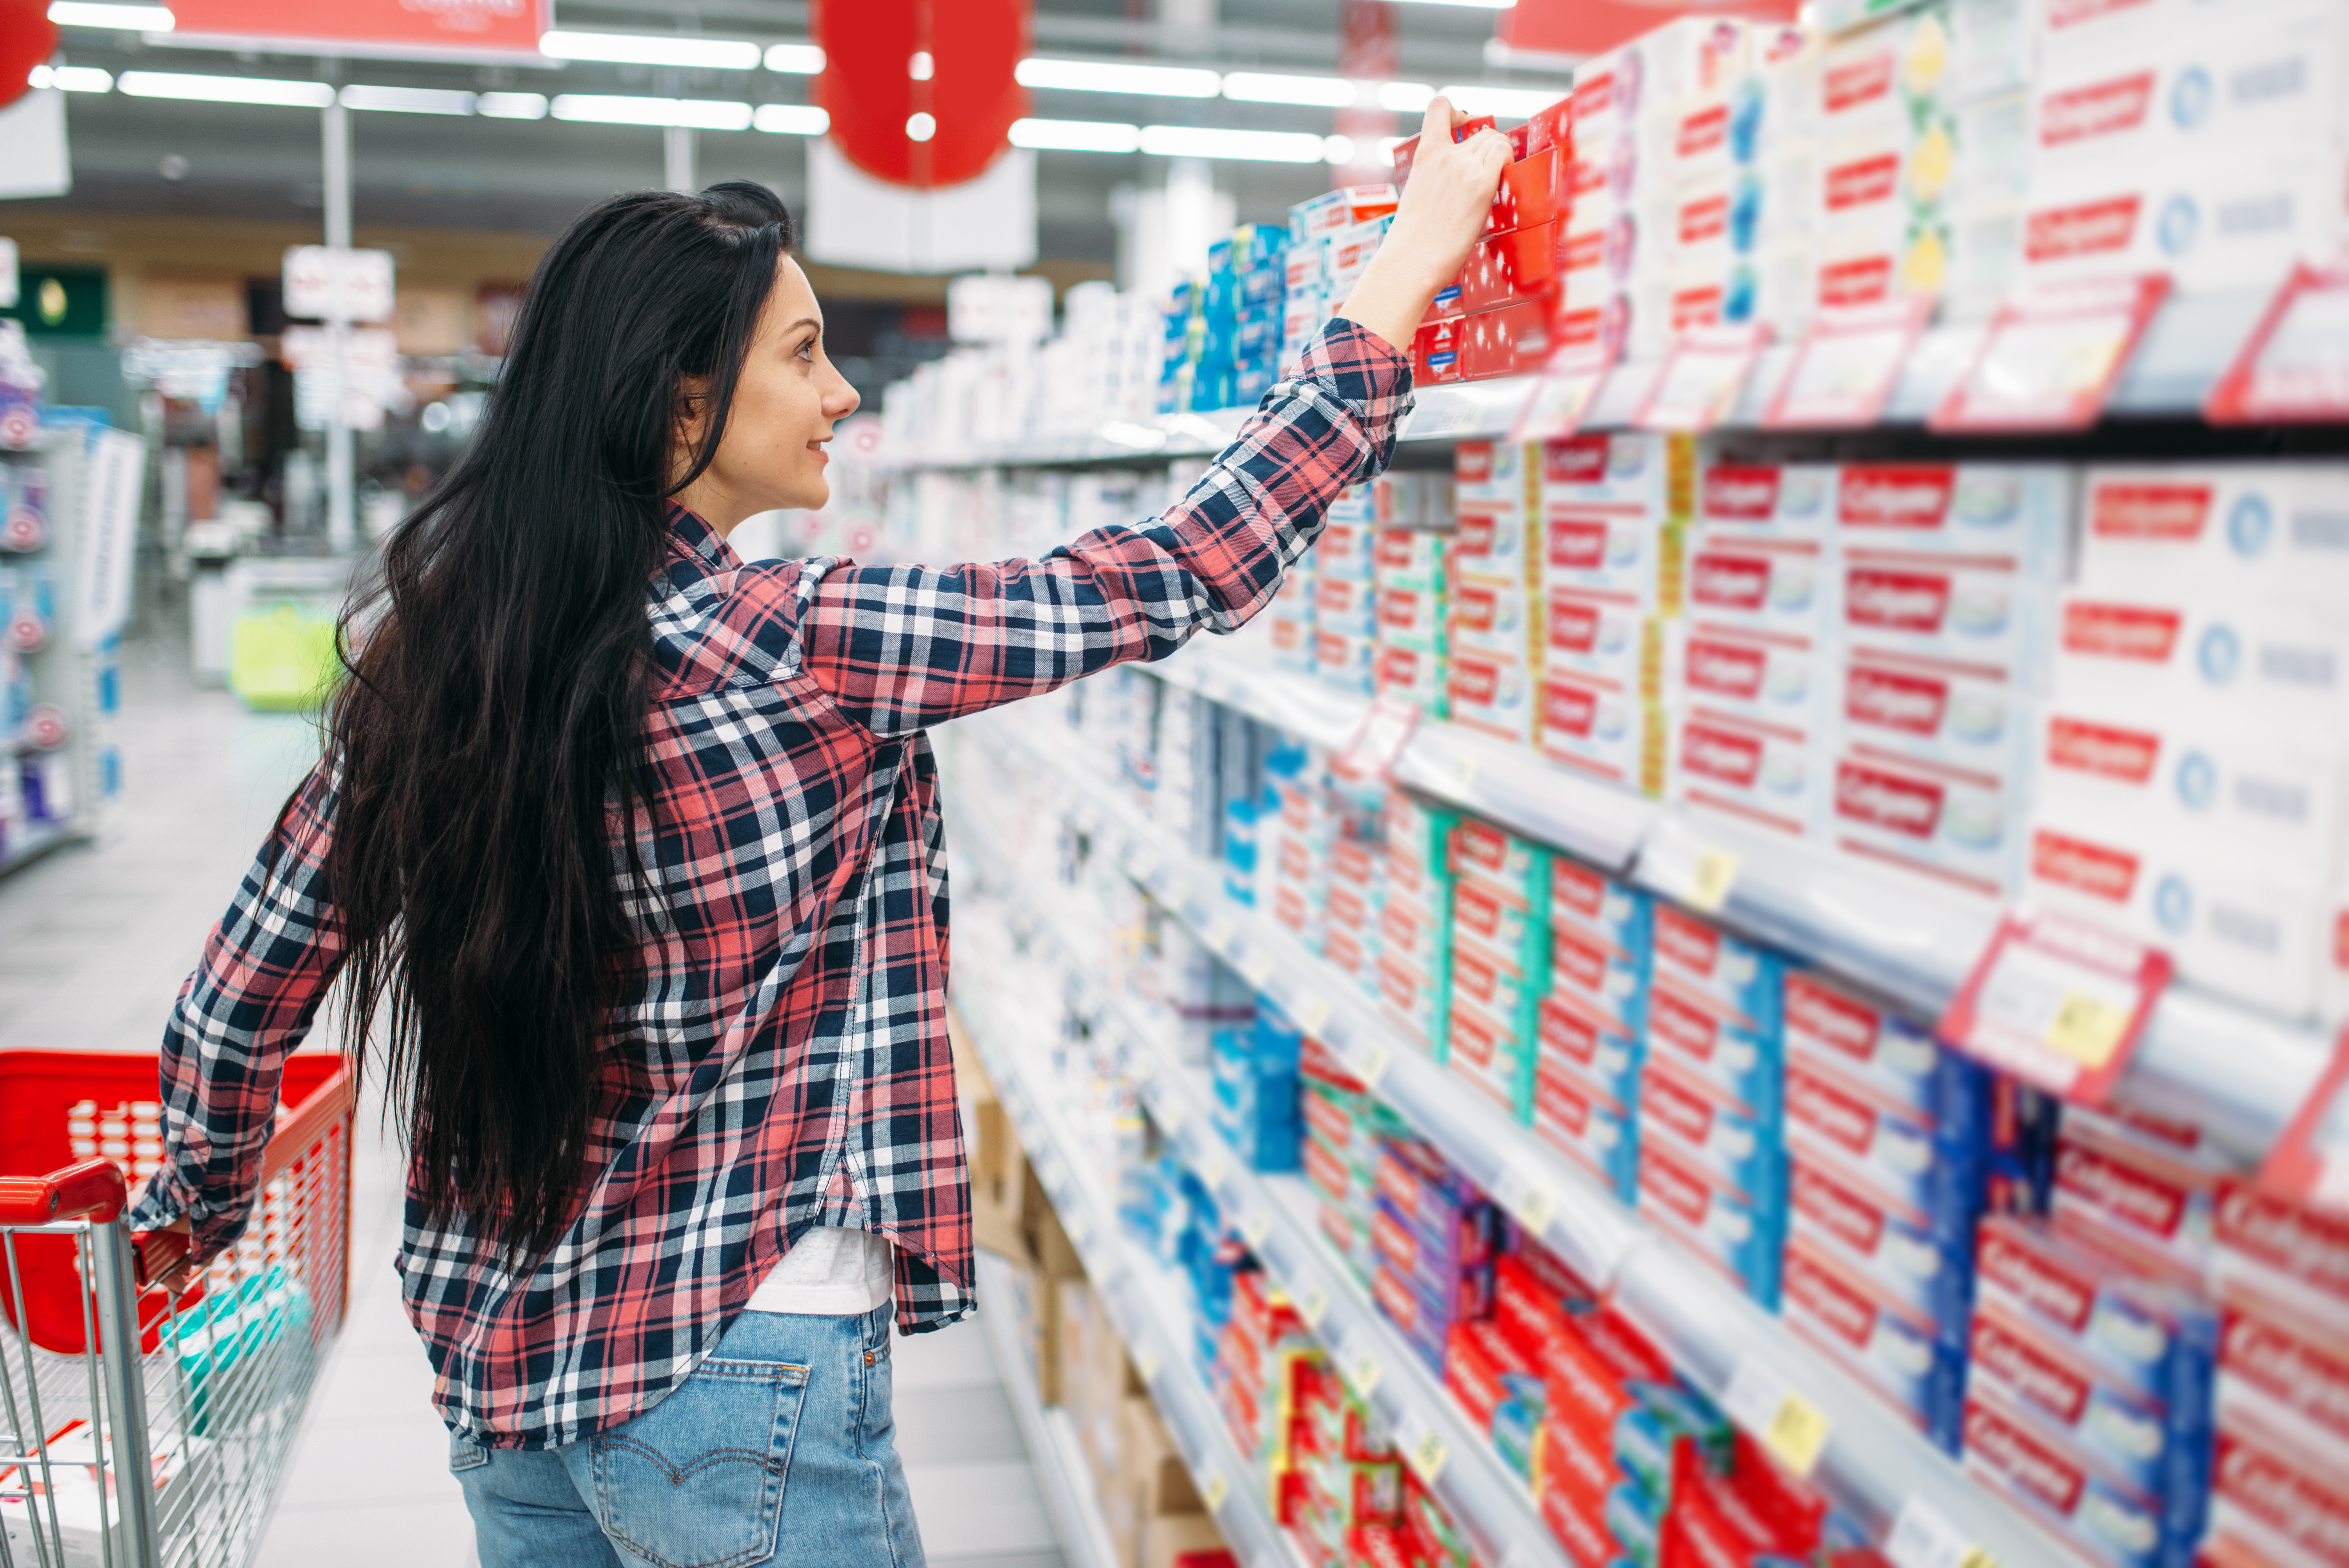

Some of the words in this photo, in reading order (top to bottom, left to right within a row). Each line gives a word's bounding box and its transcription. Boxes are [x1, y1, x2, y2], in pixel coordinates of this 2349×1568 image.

[2057, 1147, 2172, 1227] Colgate
[1980, 1236, 2085, 1322] Colgate
[1976, 1327, 2079, 1413] Colgate
[1970, 1413, 2073, 1503] Colgate
